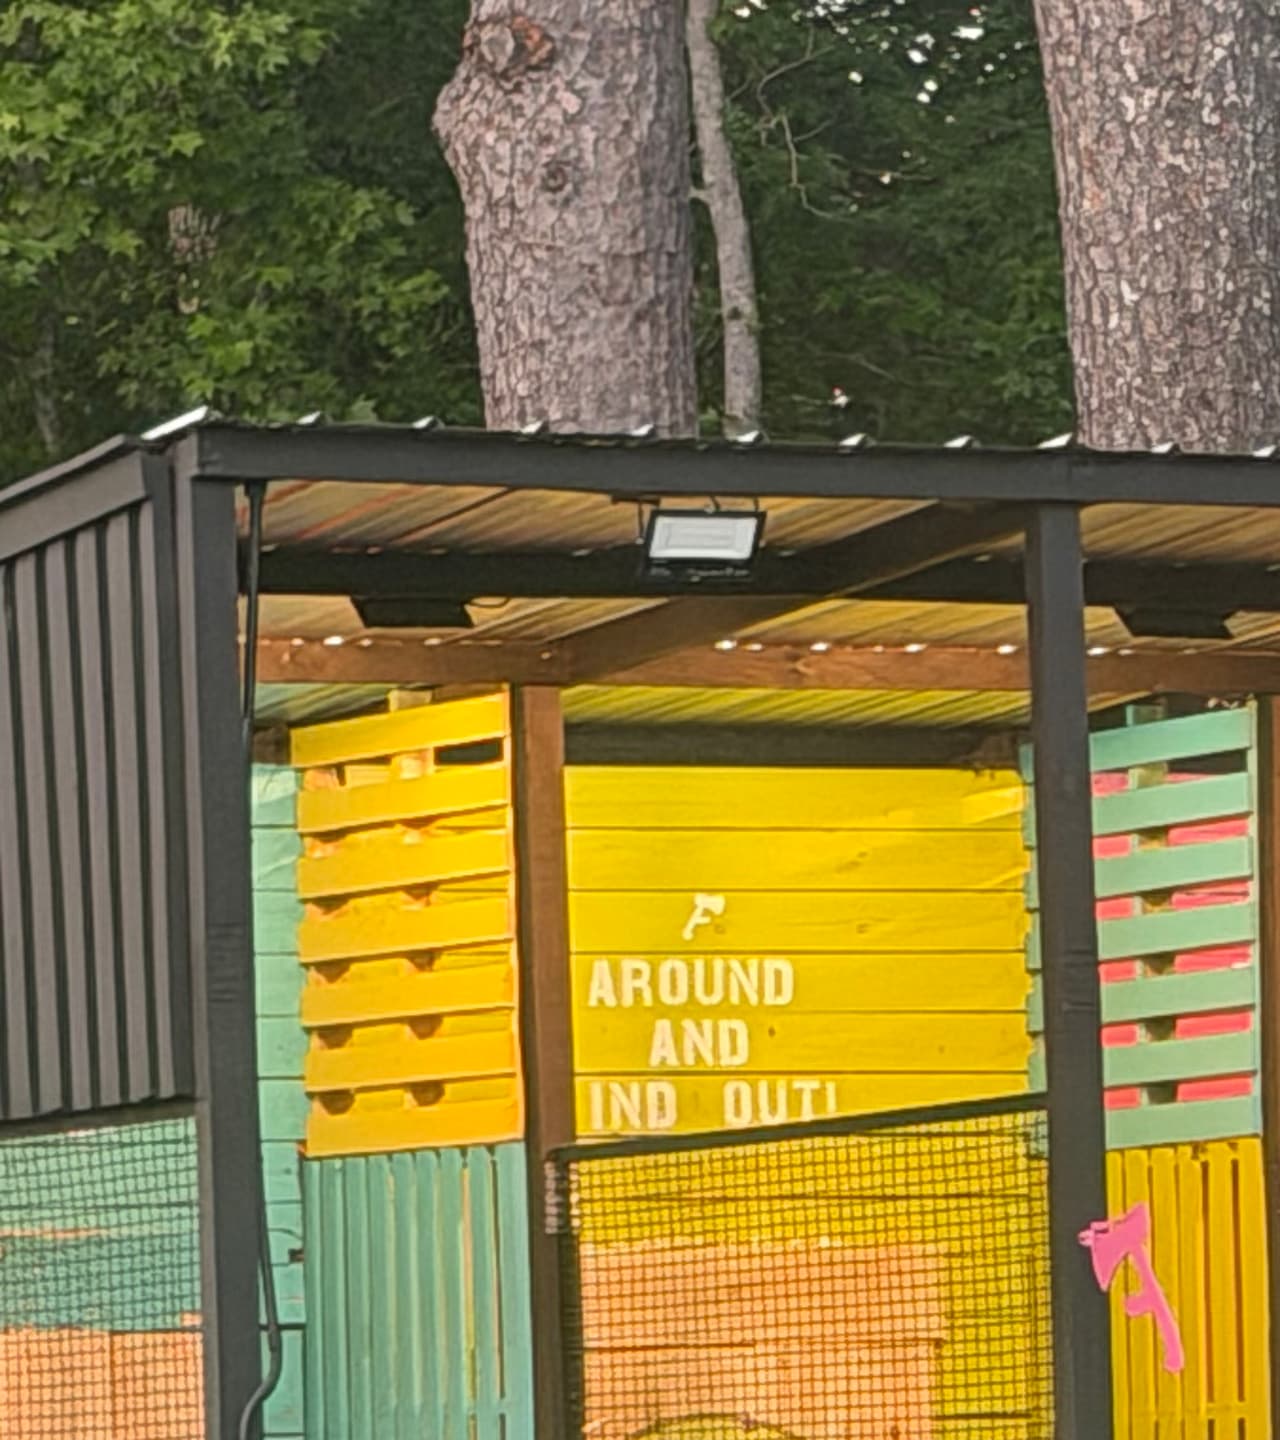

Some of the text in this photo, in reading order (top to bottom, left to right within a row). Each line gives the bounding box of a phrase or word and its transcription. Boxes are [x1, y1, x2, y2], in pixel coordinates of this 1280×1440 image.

[588, 958, 795, 1008] AROUND
[650, 1018, 749, 1067] AND
[590, 1080, 677, 1130] IND
